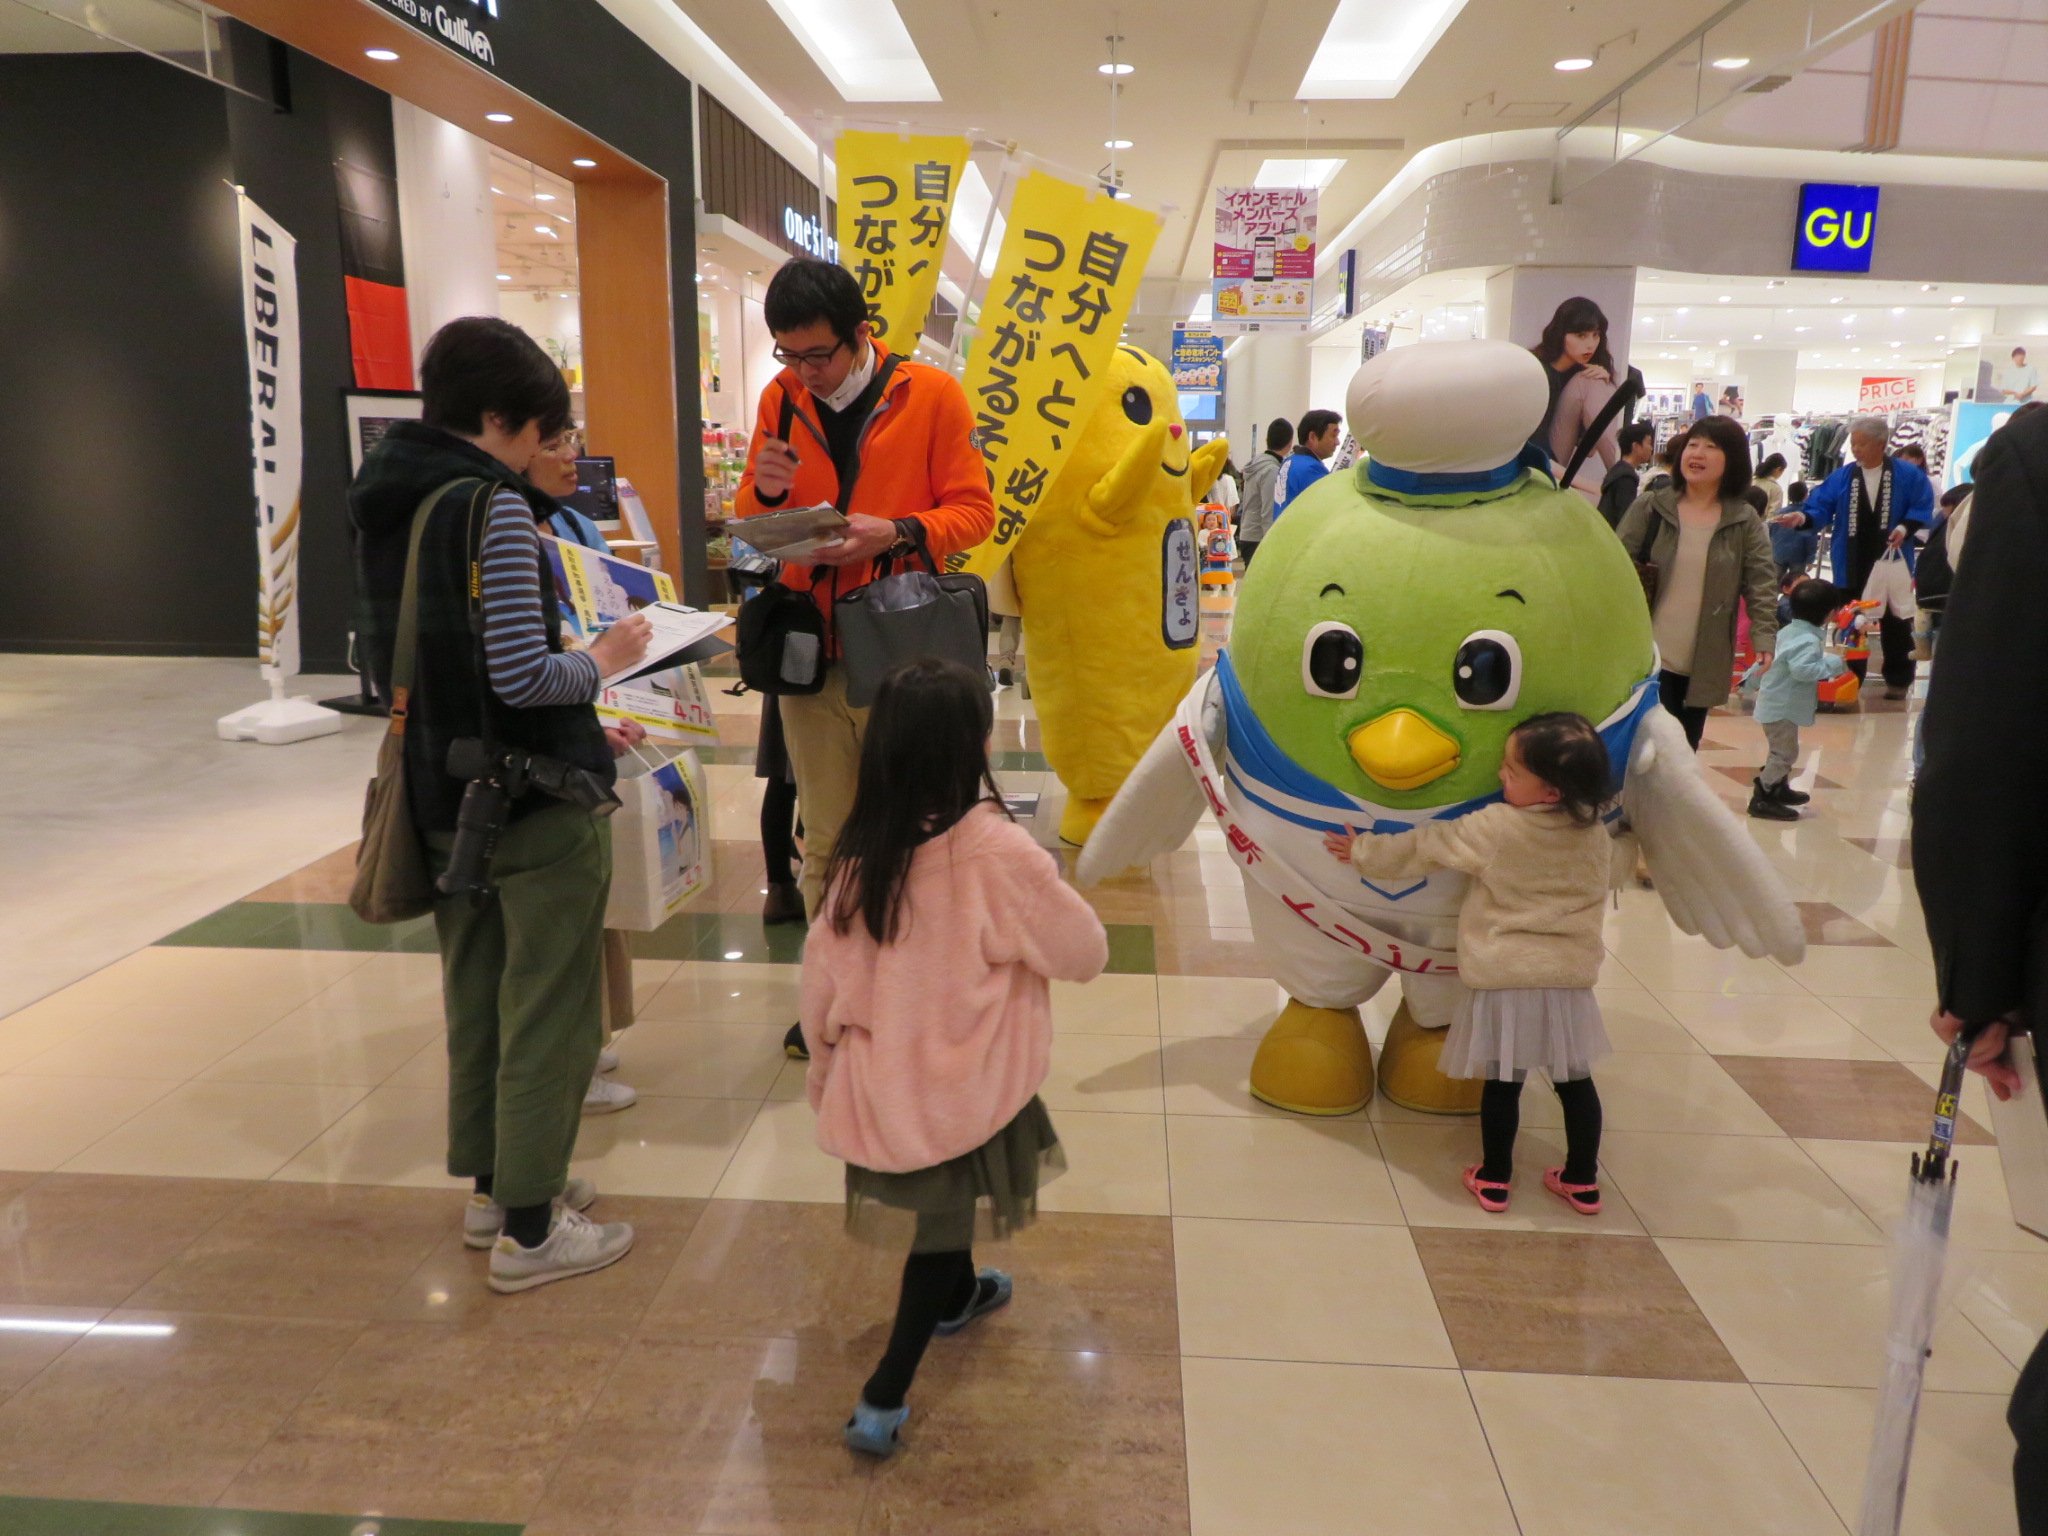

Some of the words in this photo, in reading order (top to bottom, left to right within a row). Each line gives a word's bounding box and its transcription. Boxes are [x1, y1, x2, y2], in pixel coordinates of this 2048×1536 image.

[420, 5, 432, 27] BY
[435, 5, 495, 66] Gulliver
[1225, 192, 1307, 207] イオンモール
[1244, 222, 1285, 236] アプリ
[1805, 207, 1873, 249] GU
[852, 175, 898, 339] つながる
[251, 223, 279, 523] LIBERA
[993, 231, 1129, 545] 自分へと、必ず
[1860, 379, 1917, 401] PRICE
[471, 561, 480, 598] Nikon
[1174, 540, 1192, 626] せんきょ
